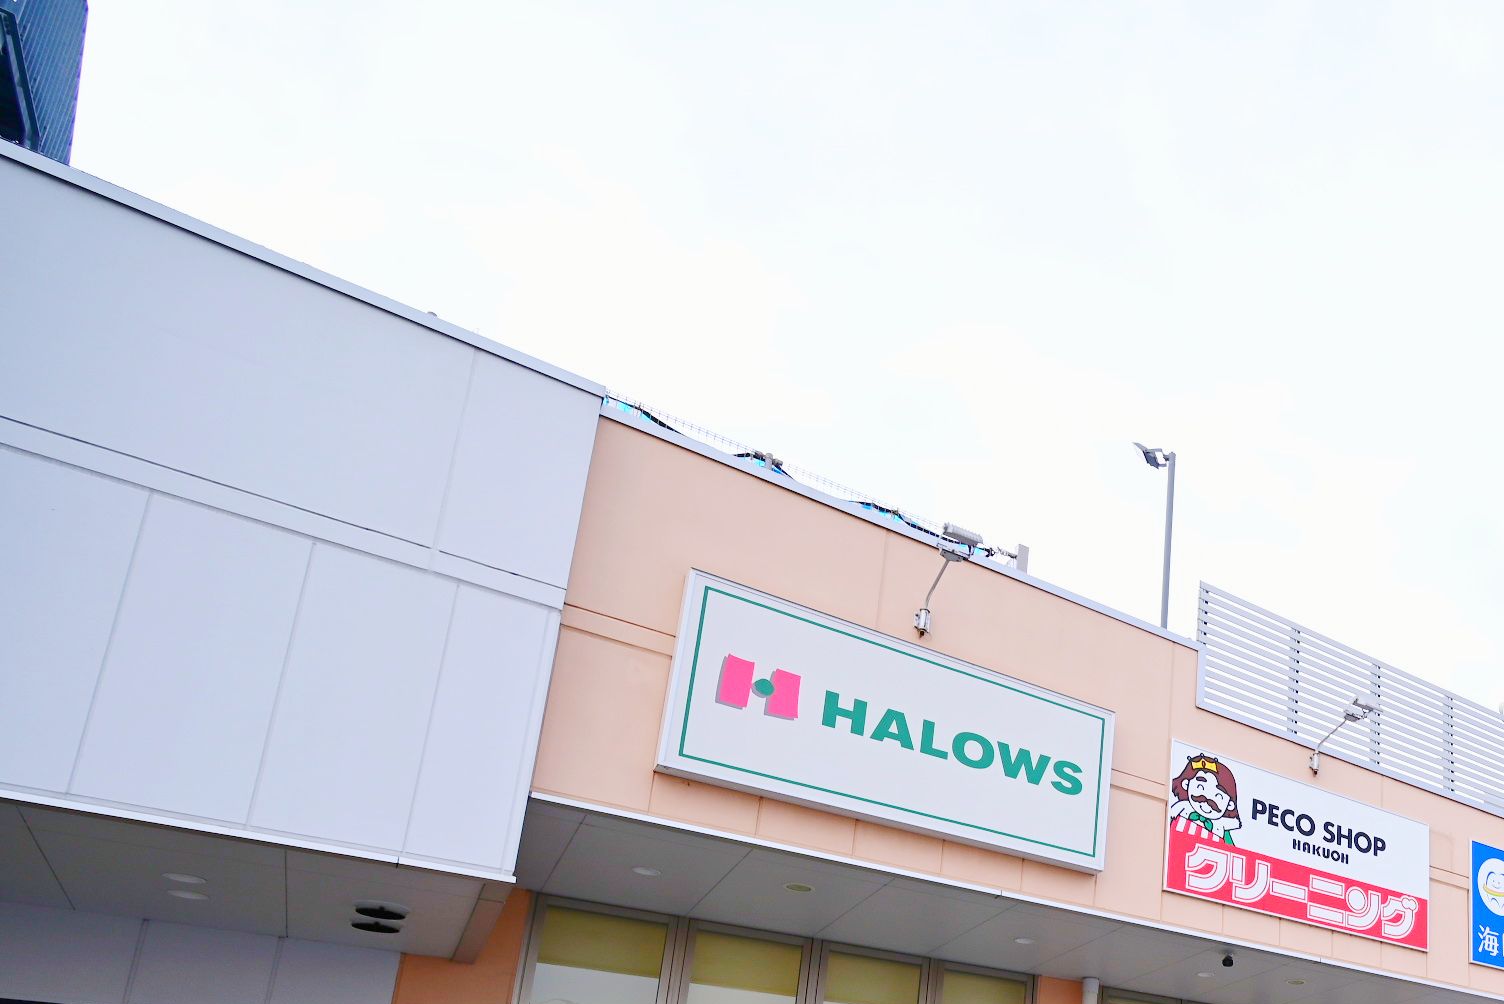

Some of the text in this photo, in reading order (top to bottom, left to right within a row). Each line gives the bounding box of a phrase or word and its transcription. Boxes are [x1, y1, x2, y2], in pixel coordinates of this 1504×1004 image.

[821, 690, 1083, 796] HALOWS
[1251, 798, 1387, 857] PECO SHOP
[1292, 838, 1349, 865] HAKUOH
[1185, 843, 1419, 939] クリーニング
